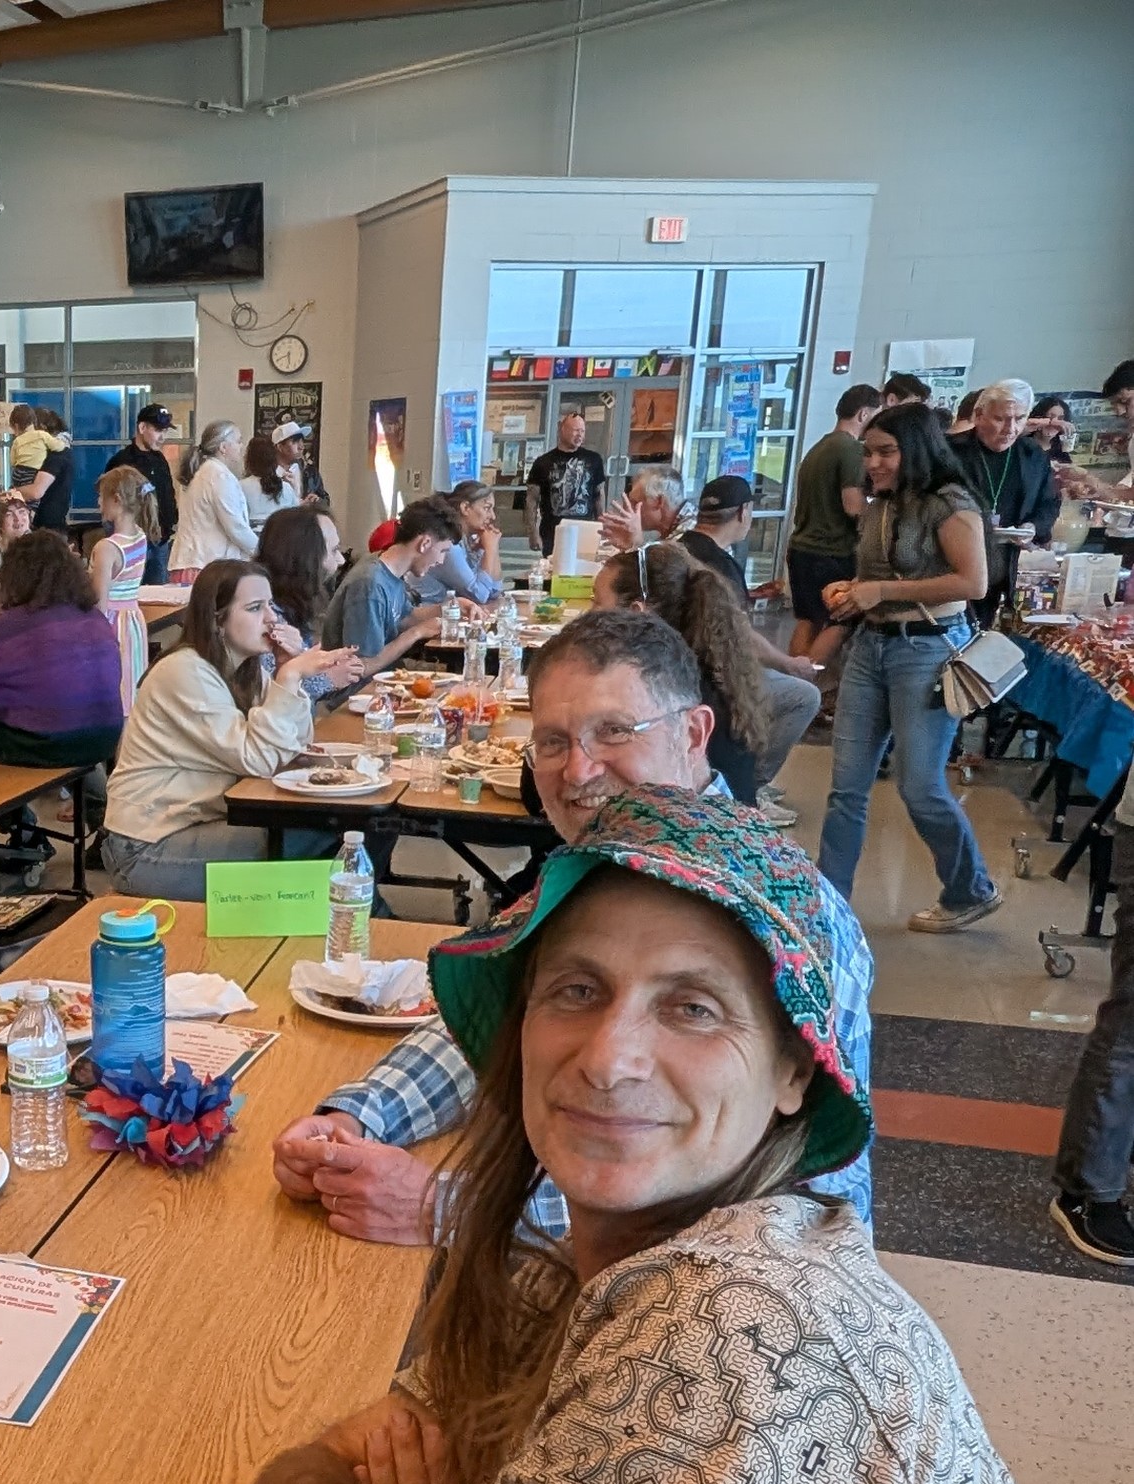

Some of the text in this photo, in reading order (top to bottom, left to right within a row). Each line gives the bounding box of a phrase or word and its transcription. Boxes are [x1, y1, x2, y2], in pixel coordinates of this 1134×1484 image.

[658, 218, 684, 240] EXIT
[3, 1282, 61, 1299] CULTURAS
[37, 1281, 53, 1289] DE
